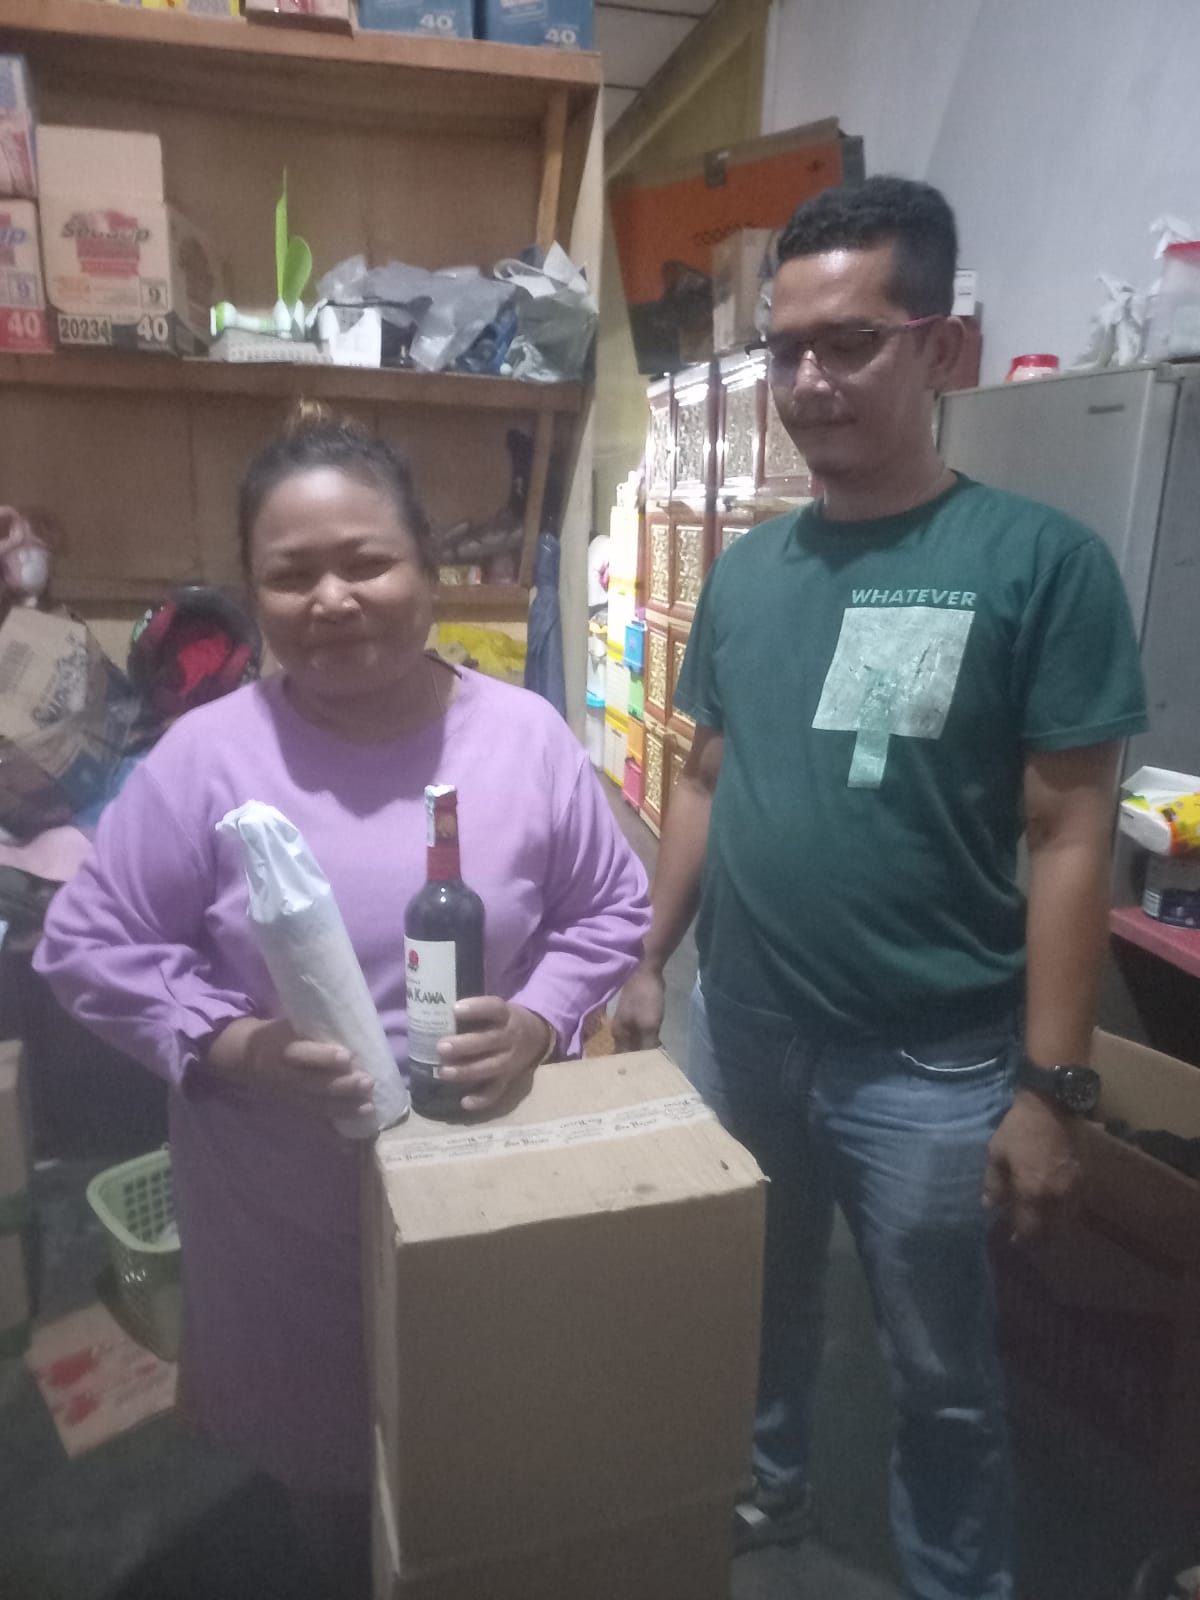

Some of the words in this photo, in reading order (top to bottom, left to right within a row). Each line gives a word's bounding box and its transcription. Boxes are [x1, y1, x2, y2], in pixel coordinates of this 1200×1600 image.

[419, 14, 453, 30] 40
[544, 28, 577, 45] 40
[7, 311, 41, 338] 40
[136, 314, 169, 343] 40
[851, 588, 977, 607] WHATEVER
[414, 988, 447, 1005] KAWA
